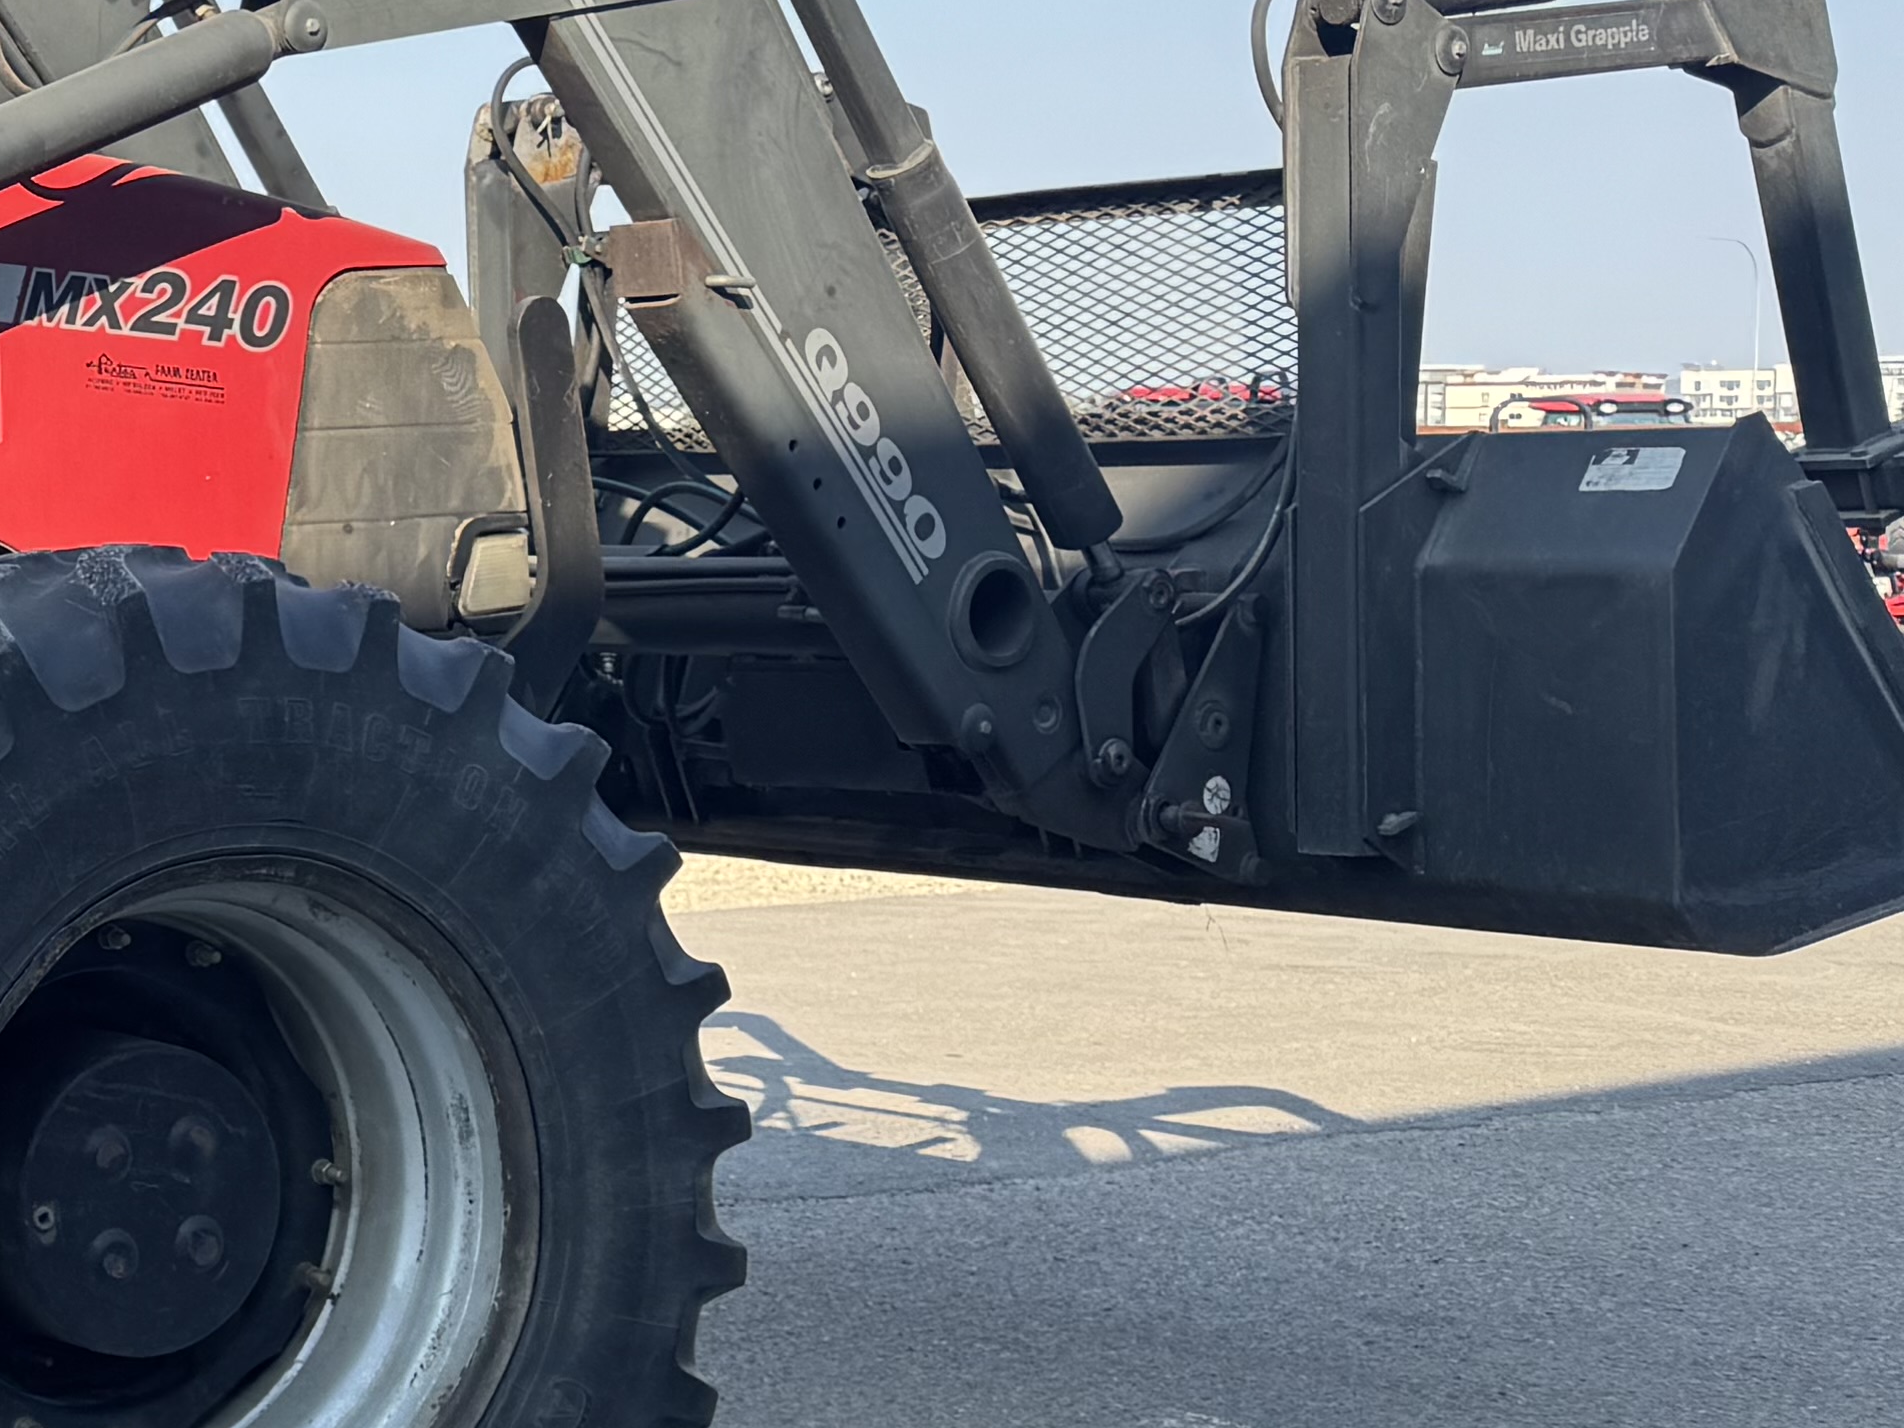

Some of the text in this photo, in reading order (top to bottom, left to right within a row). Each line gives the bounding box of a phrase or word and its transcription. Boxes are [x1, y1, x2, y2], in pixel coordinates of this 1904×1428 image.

[1515, 26, 1565, 53] Maxi
[1570, 19, 1650, 50] Grapple
[19, 266, 292, 352] MX240
[804, 327, 947, 560] Q990
